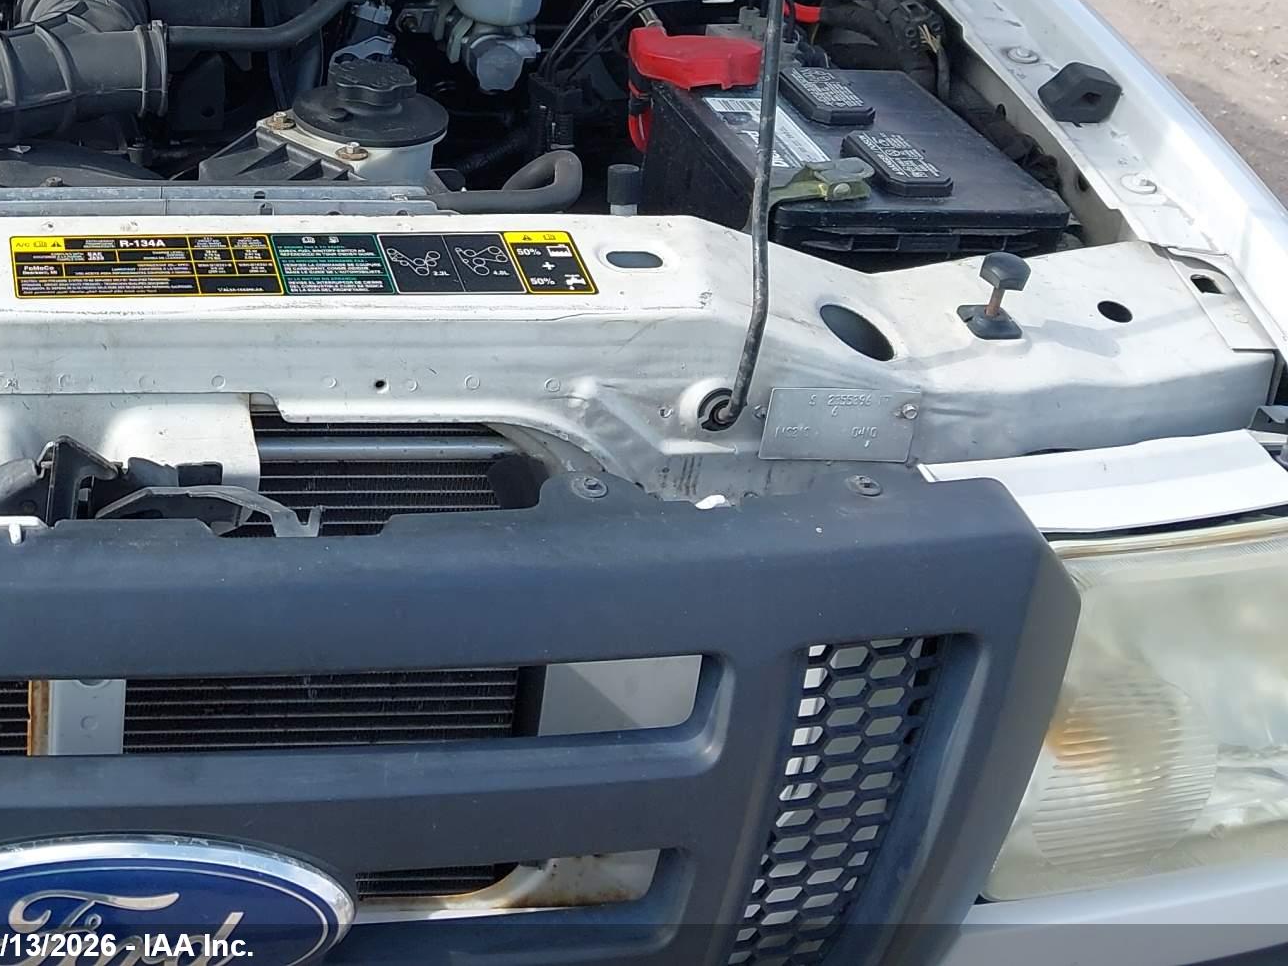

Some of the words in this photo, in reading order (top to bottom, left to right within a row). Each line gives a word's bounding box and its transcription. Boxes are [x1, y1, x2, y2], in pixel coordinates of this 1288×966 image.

[119, 239, 166, 248] R-134A
[516, 248, 542, 256] 50%
[530, 277, 556, 285] 50%
